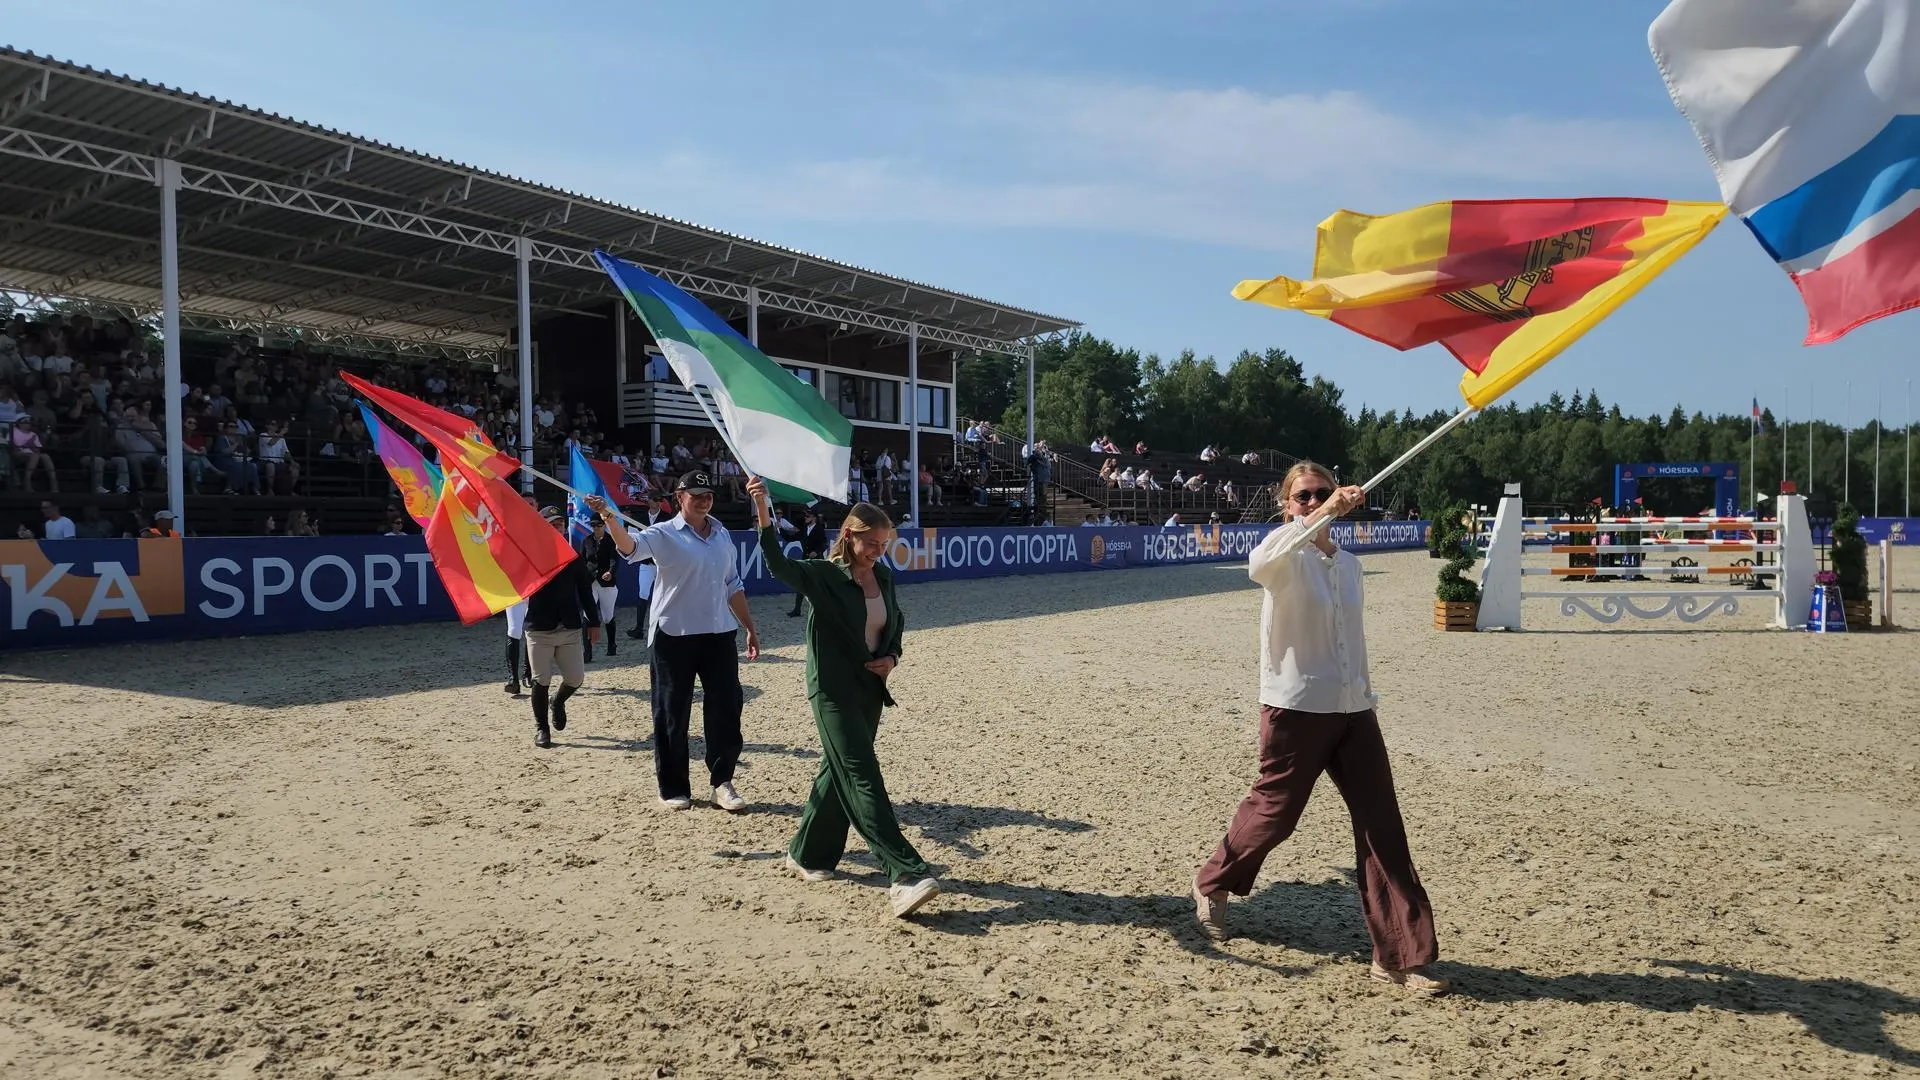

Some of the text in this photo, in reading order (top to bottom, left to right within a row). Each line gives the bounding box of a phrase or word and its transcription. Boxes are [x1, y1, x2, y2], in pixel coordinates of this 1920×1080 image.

[1220, 530, 1260, 556] SPORT
[1390, 524, 1419, 543] СПОРТА
[1000, 533, 1079, 565] СПОРТА
[198, 553, 435, 619] SPORT
